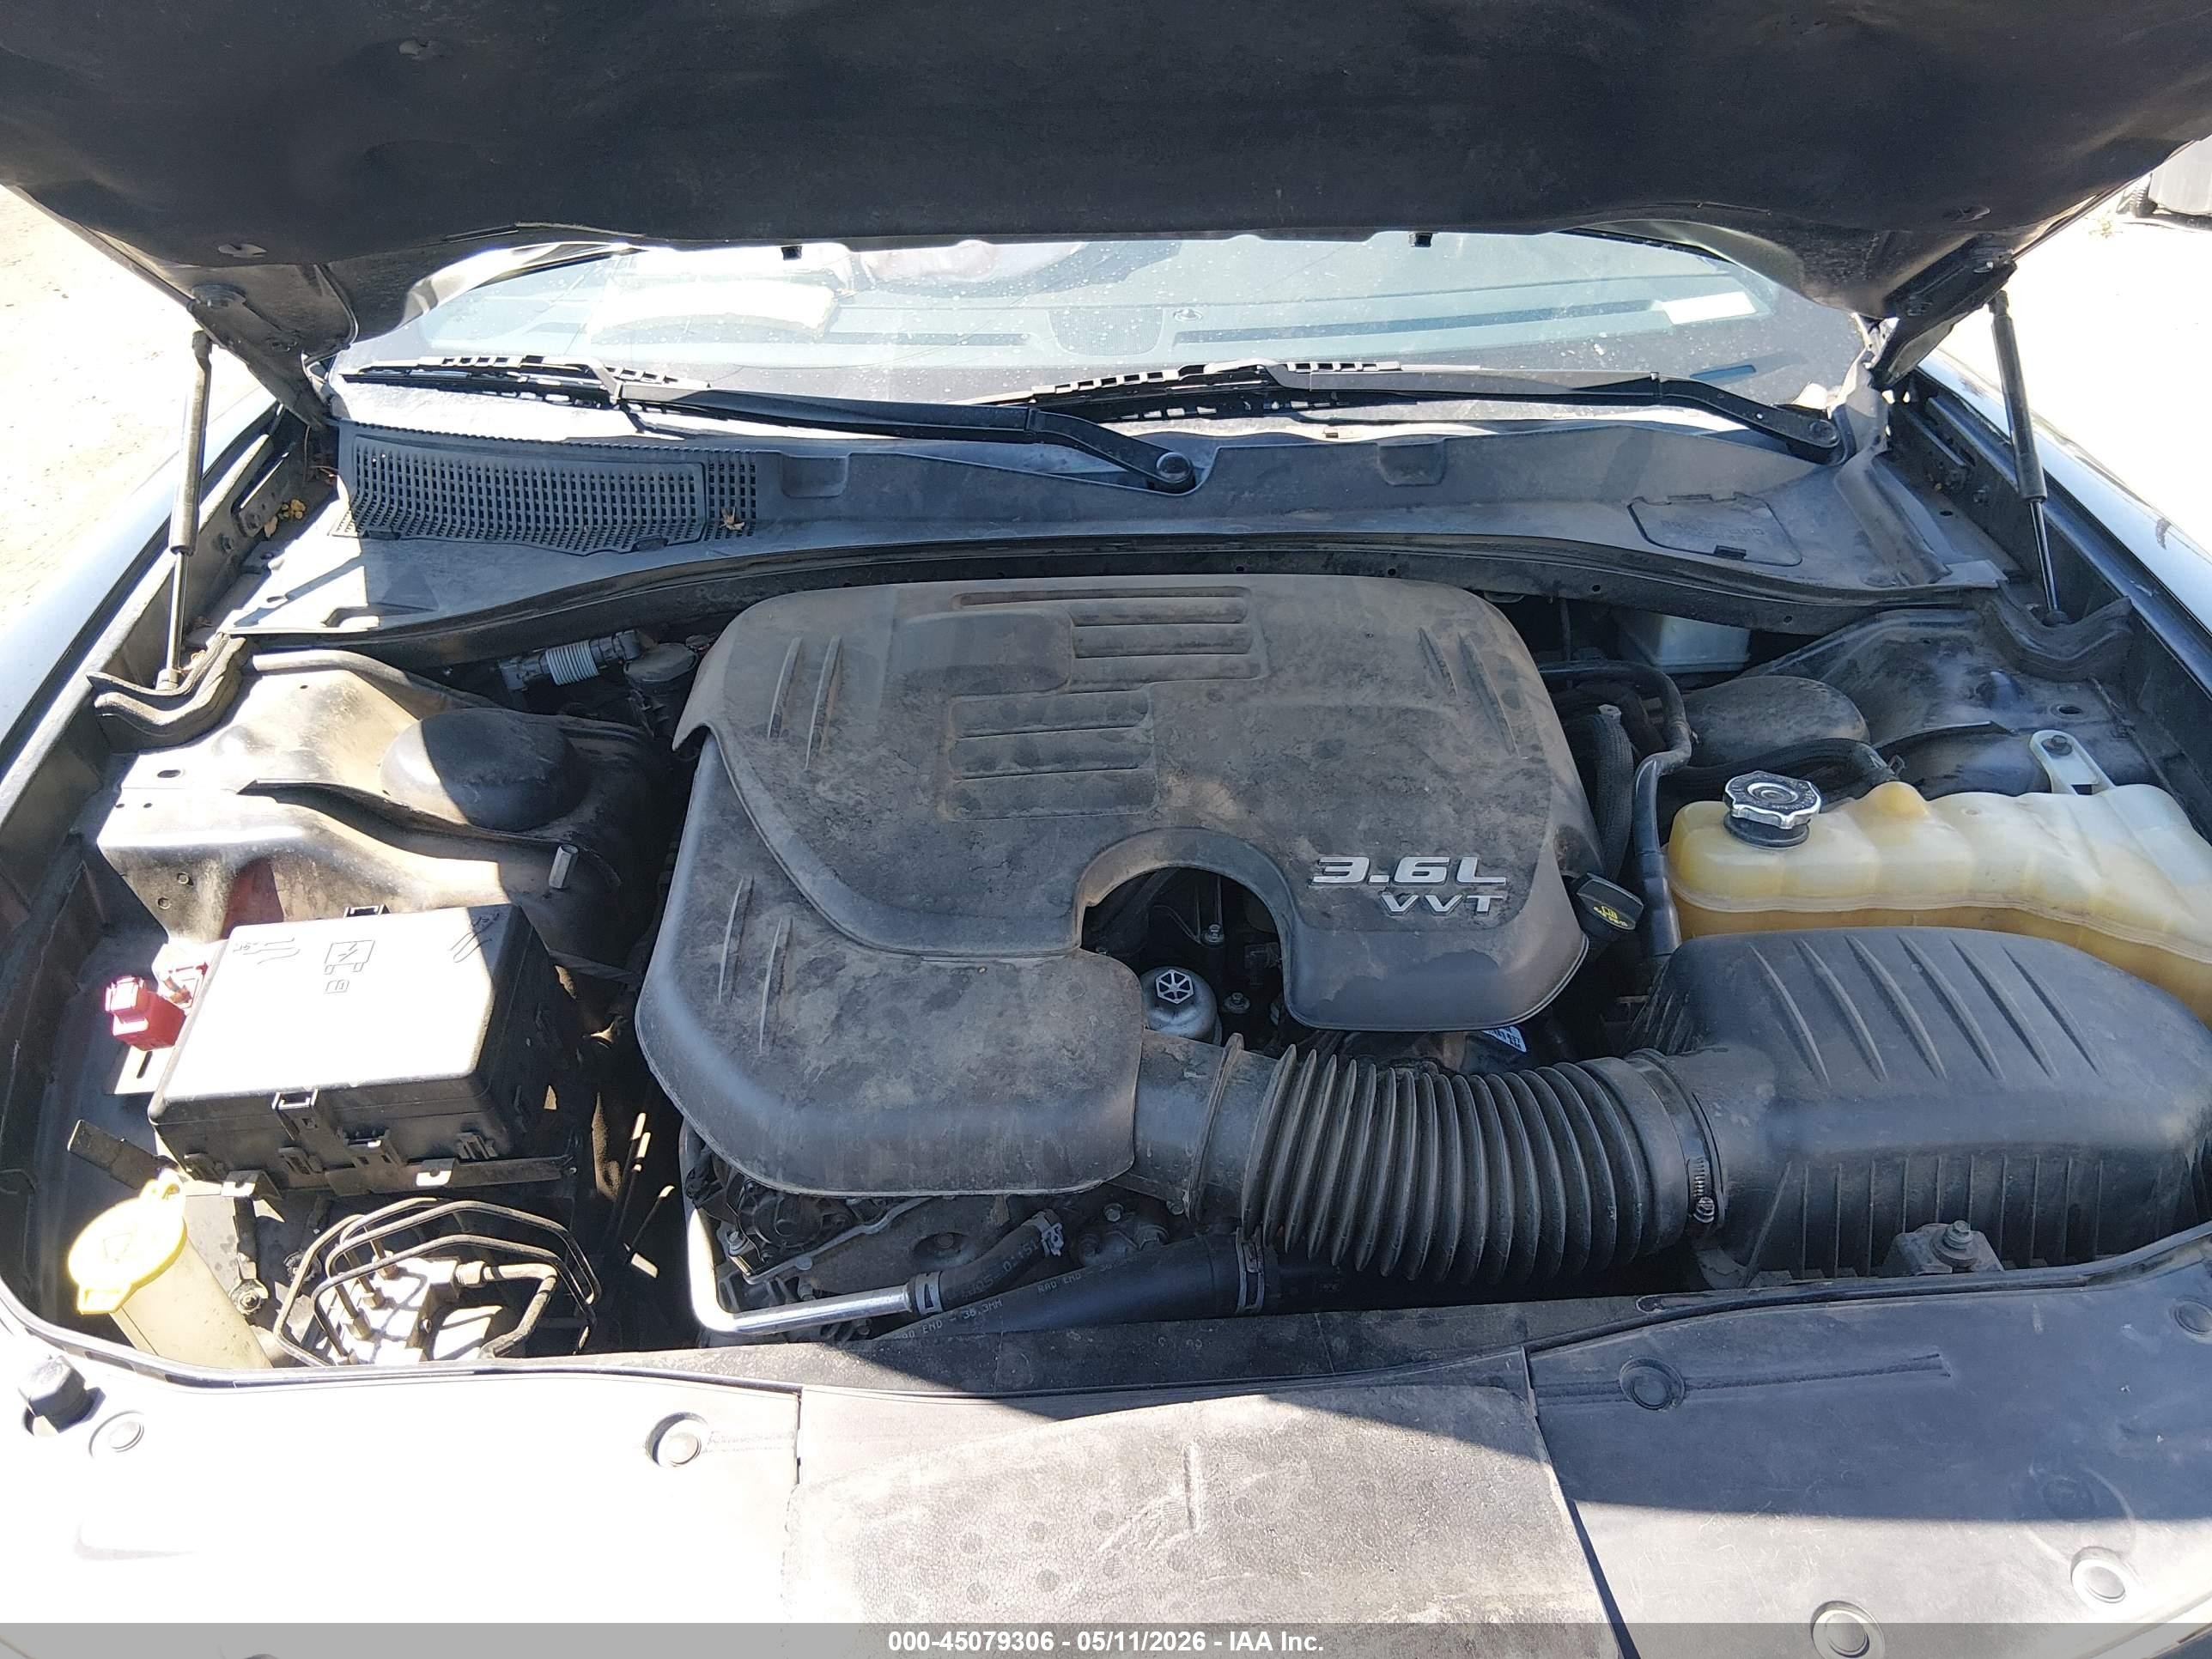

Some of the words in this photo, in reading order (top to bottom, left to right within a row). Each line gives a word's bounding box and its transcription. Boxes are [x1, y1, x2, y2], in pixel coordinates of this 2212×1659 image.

[1313, 856, 1507, 886] 3.6L
[1380, 894, 1506, 915] VVT
[922, 1319, 943, 1334] END
